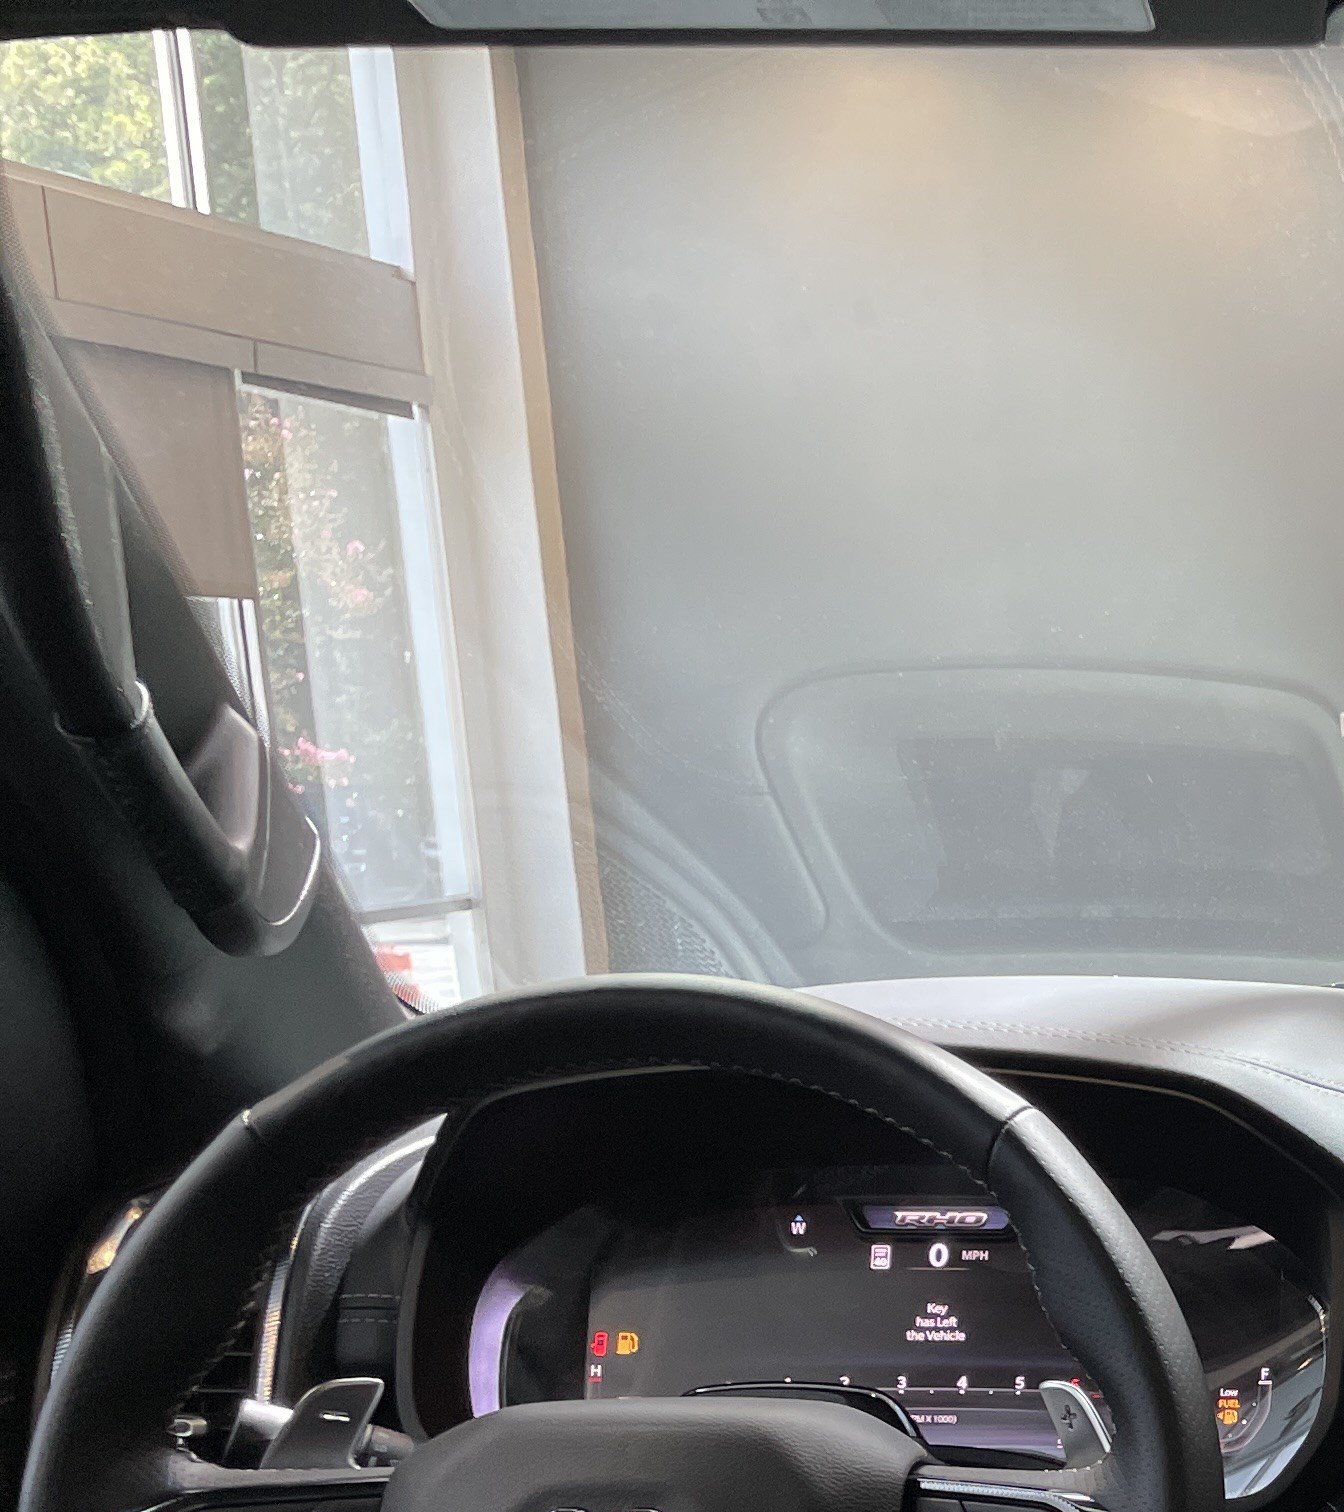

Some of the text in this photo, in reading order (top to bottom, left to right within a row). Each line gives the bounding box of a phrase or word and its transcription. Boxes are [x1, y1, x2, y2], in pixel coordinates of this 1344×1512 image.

[894, 1211, 988, 1228] RHO
[791, 1222, 807, 1235] W
[928, 1242, 989, 1268] 0 MPH
[927, 1302, 949, 1315] Key
[915, 1315, 958, 1327] has Left
[906, 1330, 966, 1341] the Vehicle
[590, 1364, 602, 1377] H
[1260, 1367, 1270, 1381] F
[896, 1375, 1026, 1389] 3 4 5
[1220, 1388, 1239, 1397] Low
